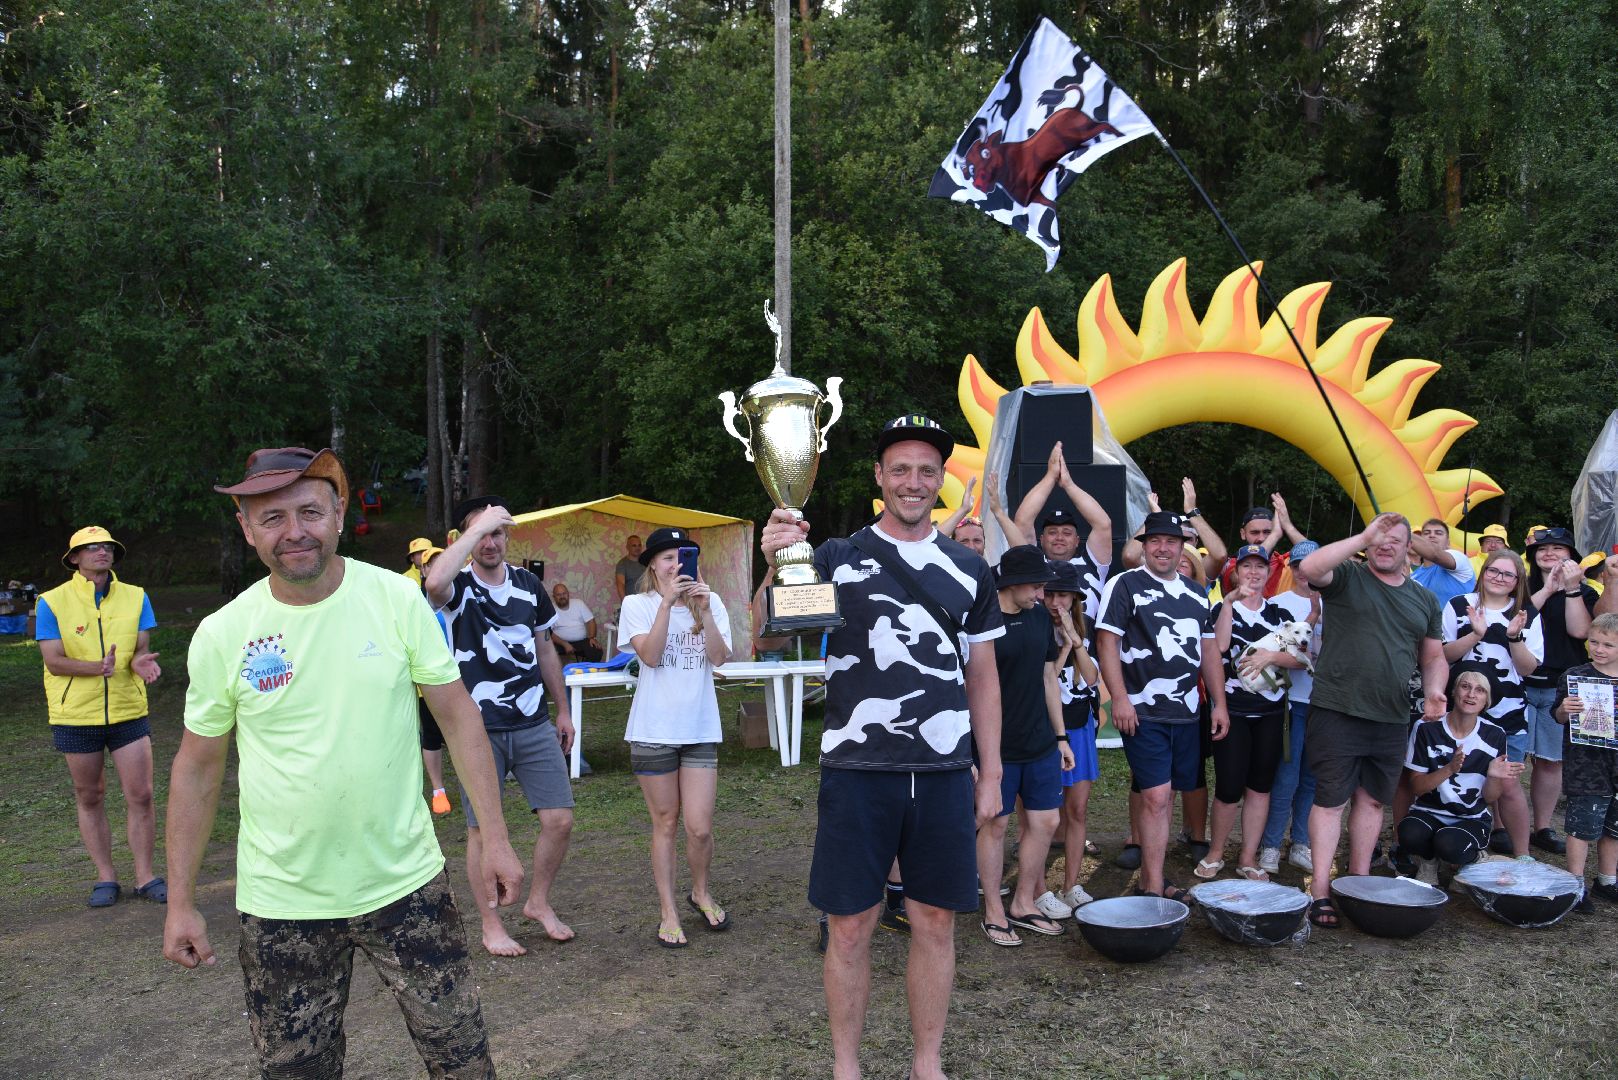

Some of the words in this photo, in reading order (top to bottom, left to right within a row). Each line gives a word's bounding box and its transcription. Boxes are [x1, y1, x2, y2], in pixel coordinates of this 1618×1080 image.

[240, 661, 293, 680] Деловой
[683, 655, 705, 670] ДЕТИ
[258, 671, 293, 692] МИР
